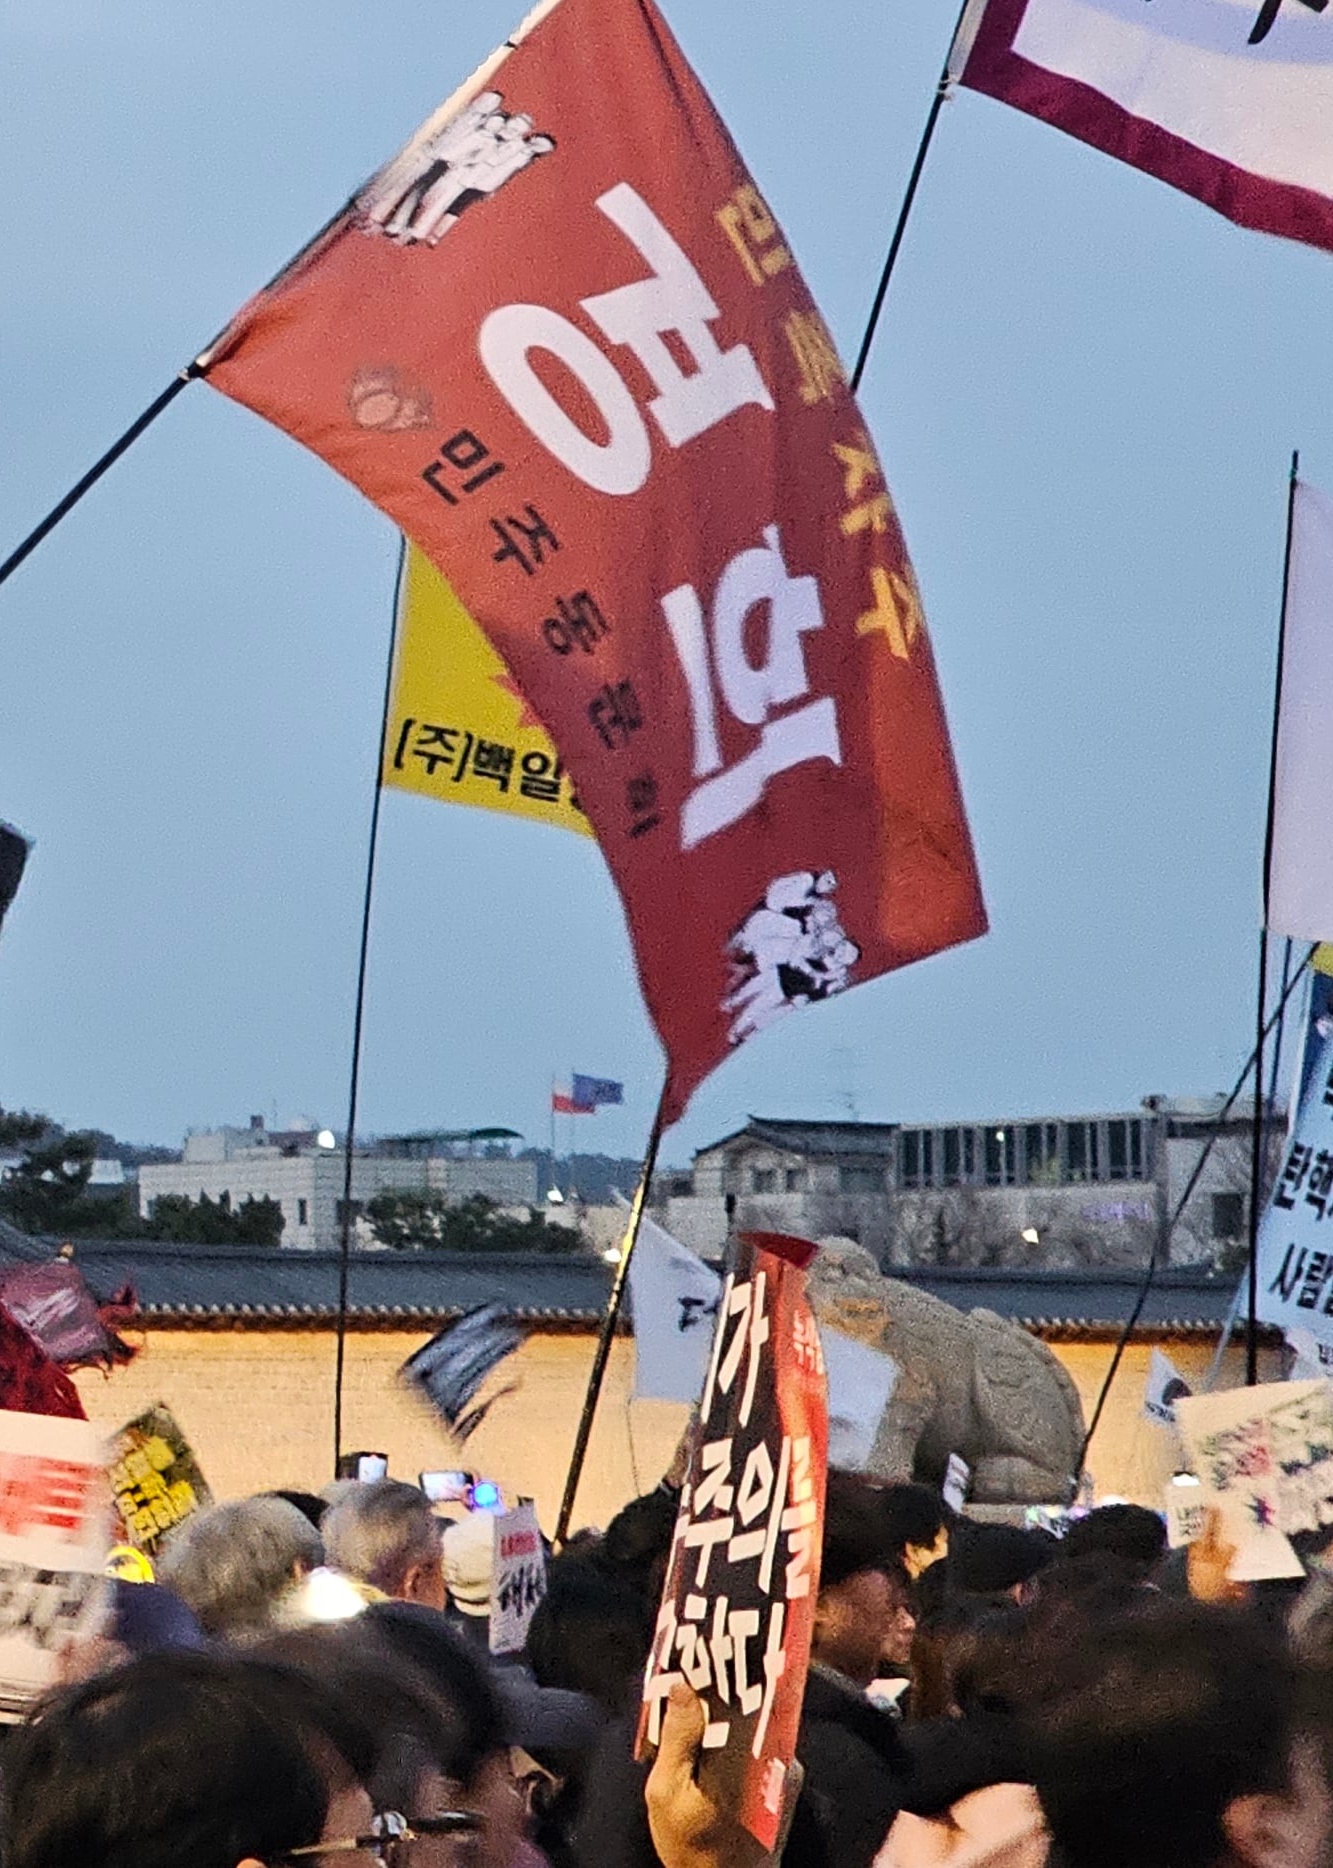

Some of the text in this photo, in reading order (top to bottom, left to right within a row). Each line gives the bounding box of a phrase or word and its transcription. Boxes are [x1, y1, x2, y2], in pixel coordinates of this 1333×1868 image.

[478, 182, 844, 850] 경희
[394, 718, 583, 811] (주)백일
[668, 1434, 819, 1600] 주의를
